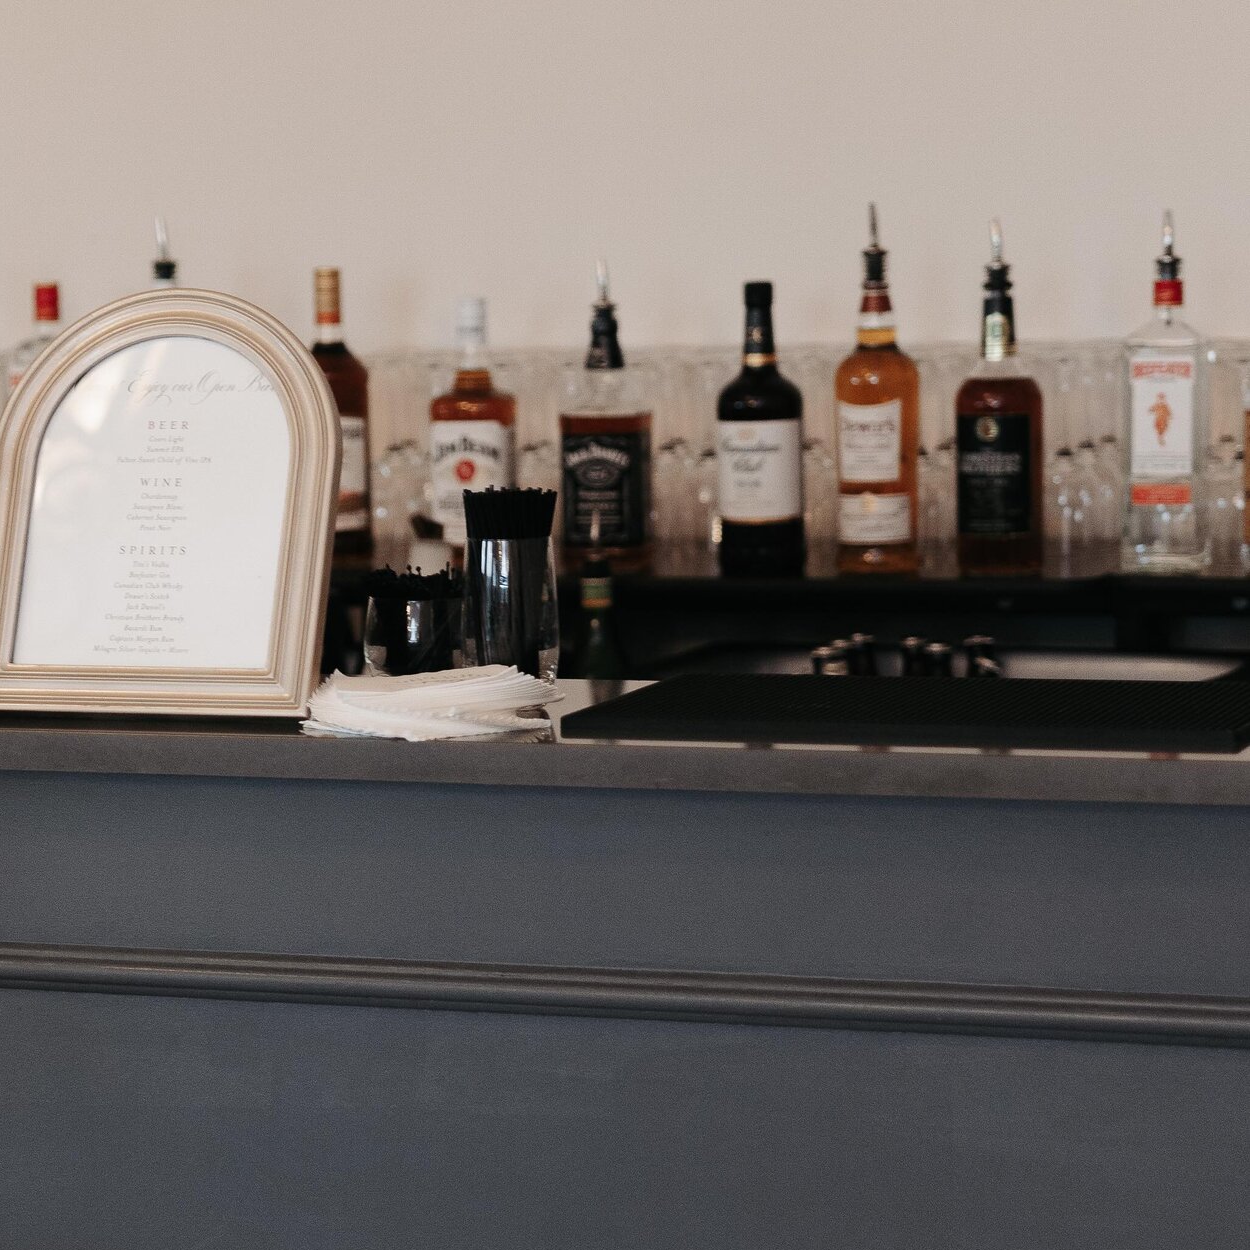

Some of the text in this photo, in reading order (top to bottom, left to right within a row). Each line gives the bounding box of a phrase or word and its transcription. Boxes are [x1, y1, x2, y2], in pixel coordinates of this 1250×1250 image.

[147, 420, 189, 430] BEER
[140, 478, 182, 487] WINE
[119, 545, 187, 556] SPIRITS
